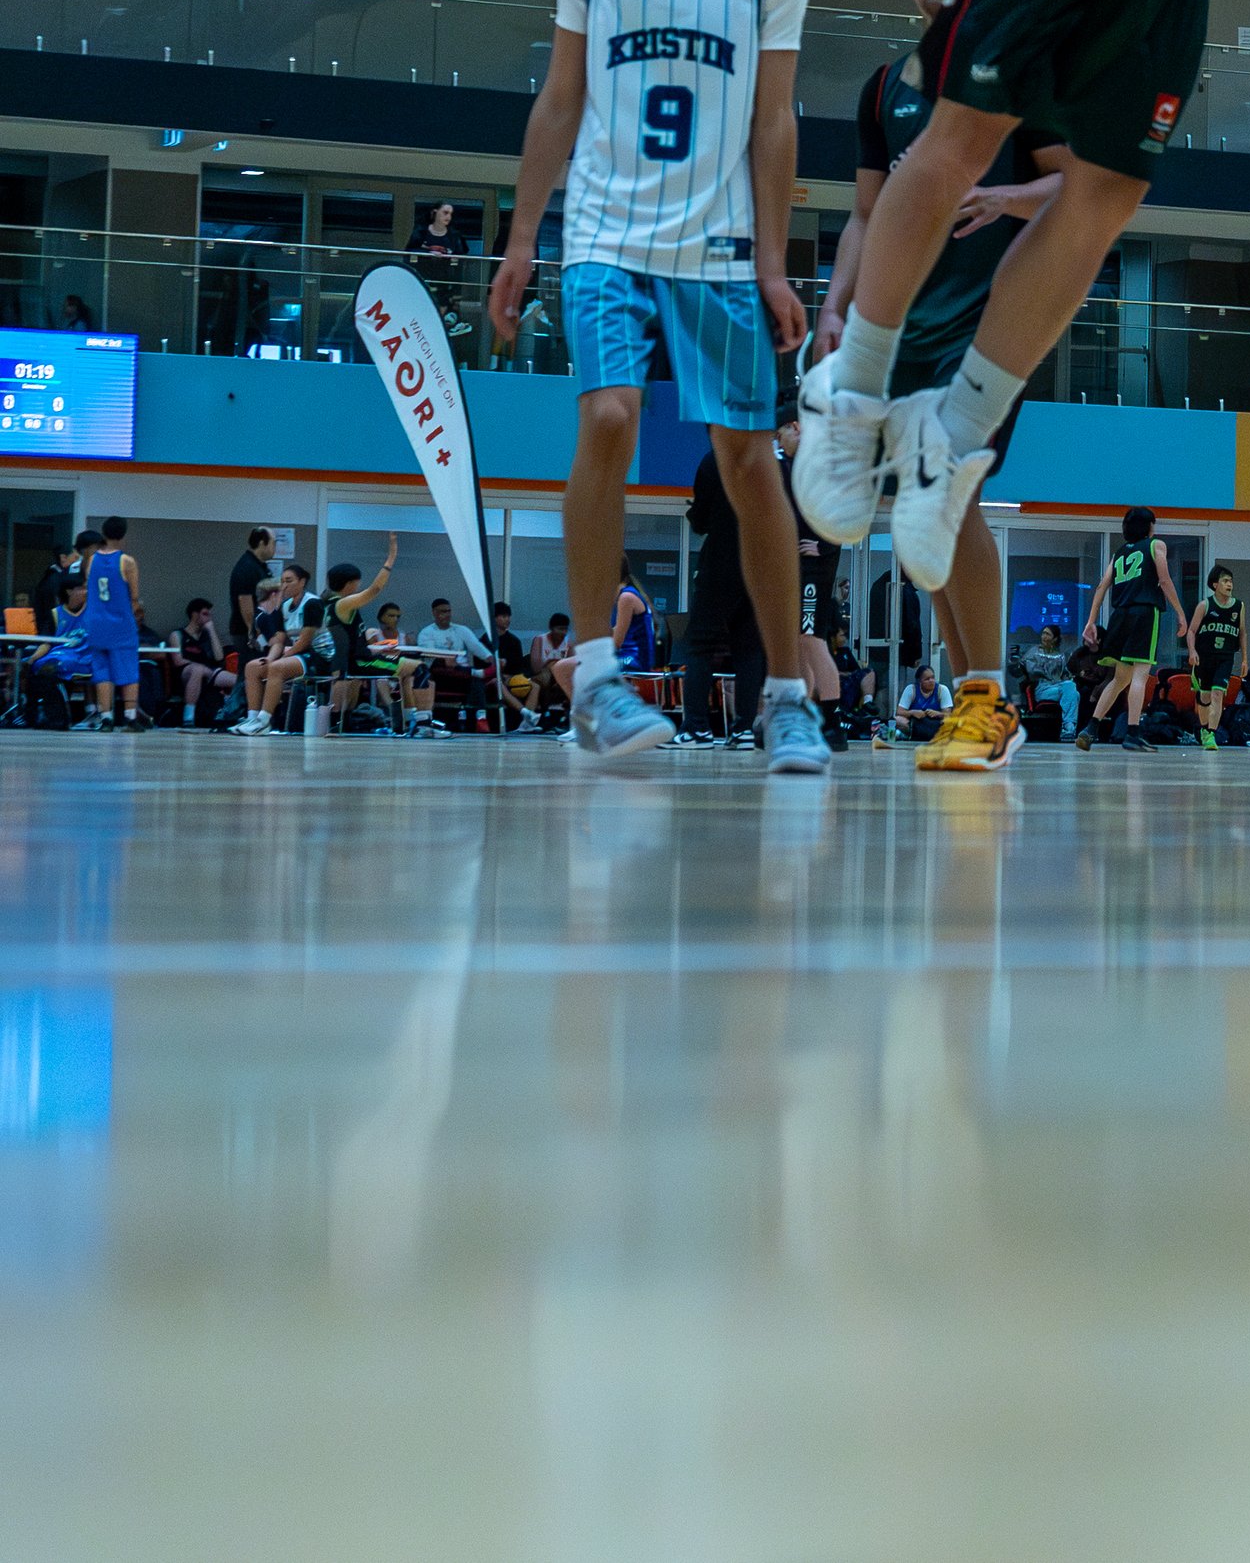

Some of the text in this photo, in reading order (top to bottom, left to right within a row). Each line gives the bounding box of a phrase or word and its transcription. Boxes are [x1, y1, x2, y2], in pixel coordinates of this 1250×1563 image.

[607, 28, 736, 76] KRISTIN
[642, 85, 694, 163] 9
[409, 318, 456, 409] WATCH LIVE ON
[1114, 550, 1144, 585] 12
